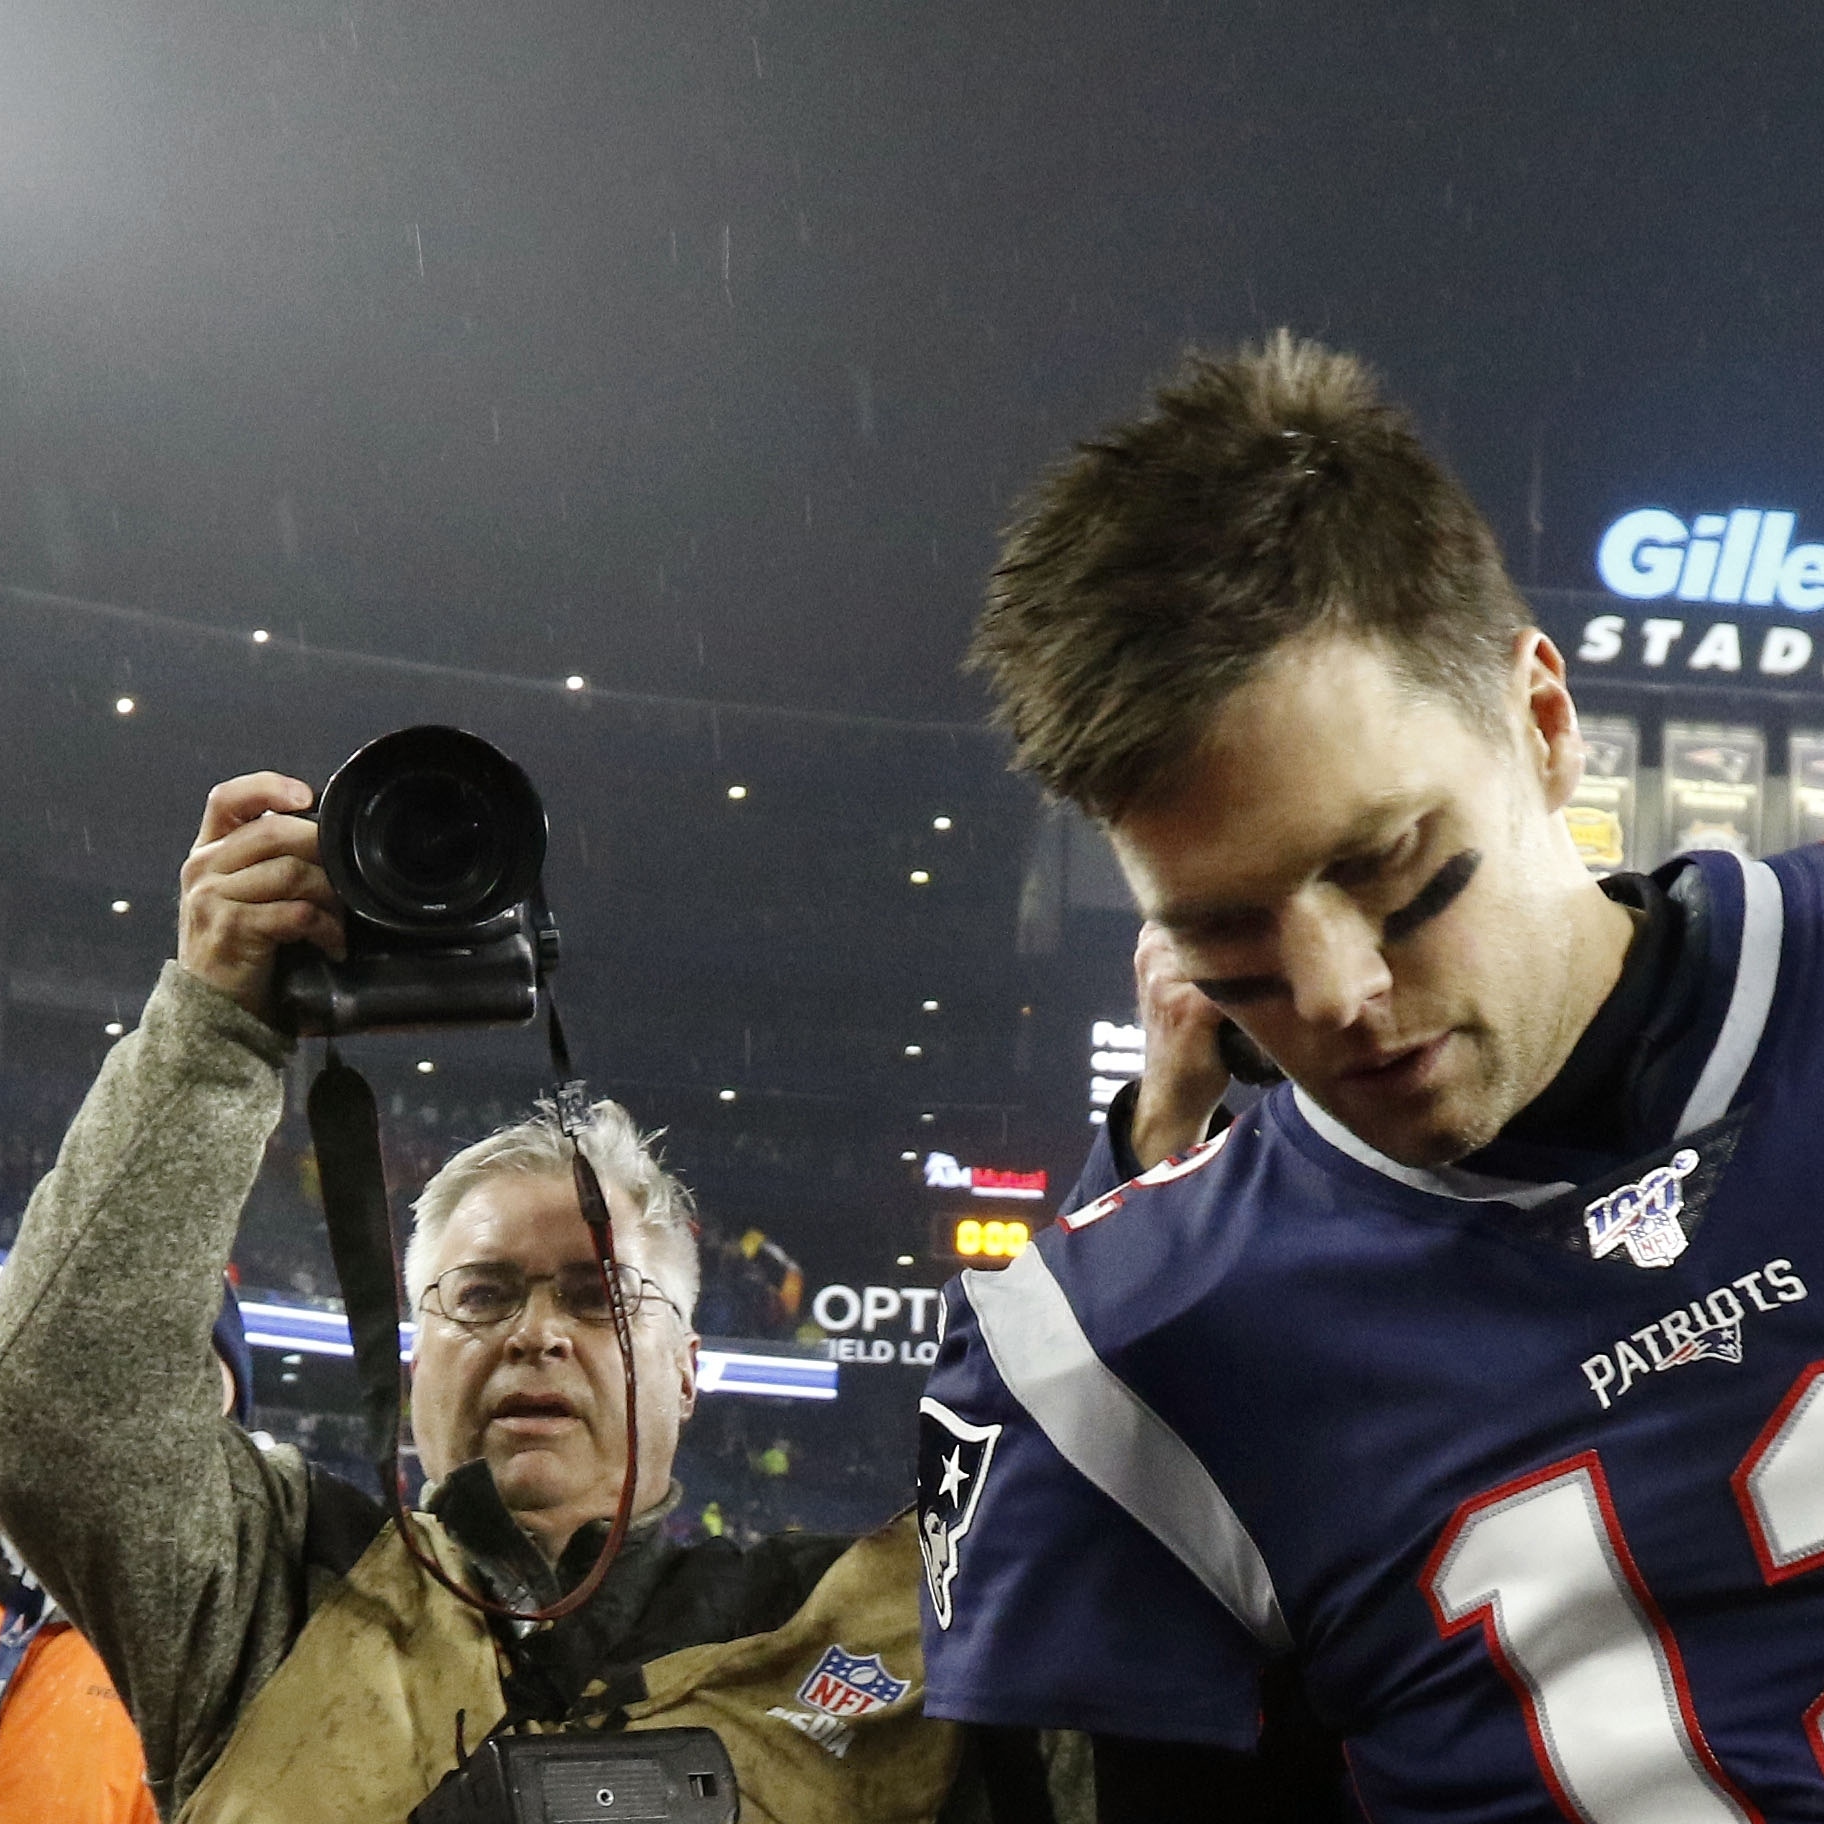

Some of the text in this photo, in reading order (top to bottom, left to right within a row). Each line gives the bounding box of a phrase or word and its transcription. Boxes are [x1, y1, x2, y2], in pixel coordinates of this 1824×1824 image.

[813, 1284, 938, 1333] OPT
[820, 1338, 939, 1365] IELD LO
[1580, 1258, 1808, 1409] PATRIOTS
[806, 1674, 876, 1715] NFL
